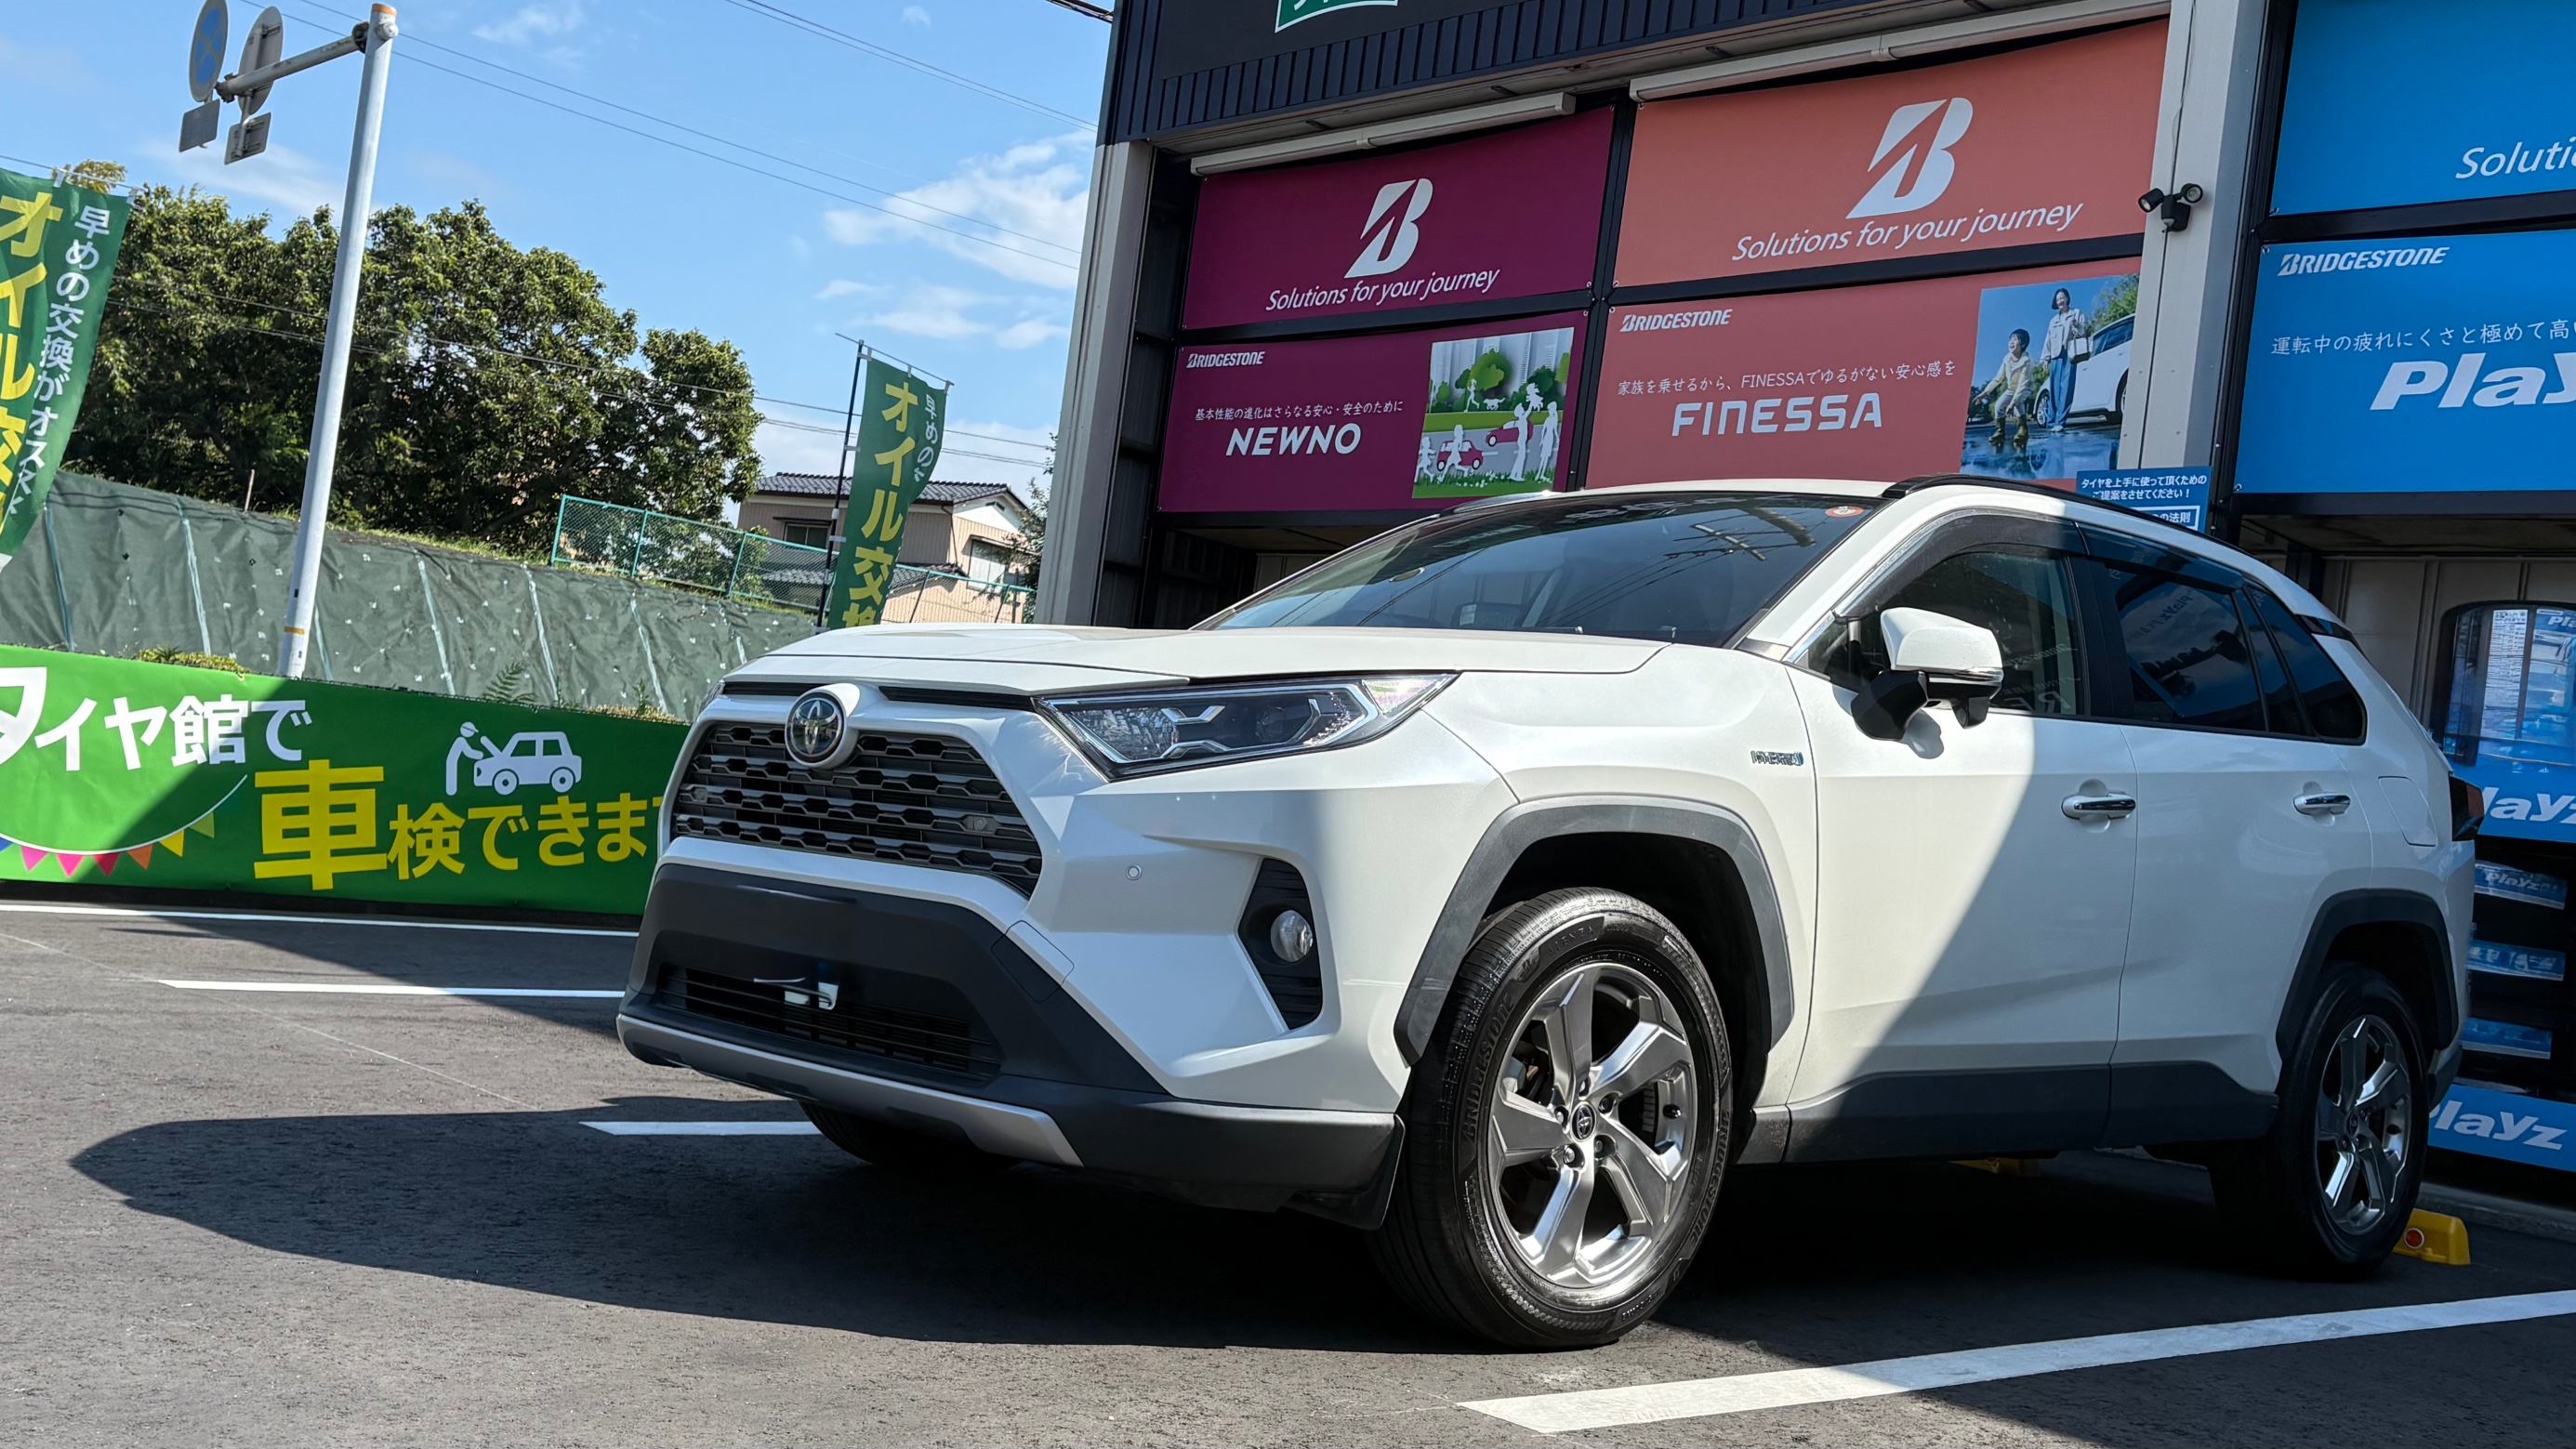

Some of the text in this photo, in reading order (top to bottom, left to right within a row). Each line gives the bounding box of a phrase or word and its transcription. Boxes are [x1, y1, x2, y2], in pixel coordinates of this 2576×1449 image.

[1732, 203, 2084, 260] Solutions for your journey
[2277, 246, 2450, 276] BRIDGESTONE
[1265, 269, 1500, 311] Solutions for your journey
[1619, 309, 1733, 333] BRIDGESTONE
[2271, 319, 2576, 355] 運転中の疲れにくさと極めて高
[1186, 350, 1265, 368] BRIDGESTONE
[1618, 360, 1956, 396] 家族を乗せるから、FINESSAでゆるがない安心感を
[1195, 400, 1404, 421] 基本性能の進化はさらなる安心・安全のために
[1671, 392, 1882, 437] FINESSA
[1225, 422, 1362, 456] NEWNO
[2081, 475, 2208, 489] タイヤを上手に使って頂くための
[254, 759, 666, 890] 車検できま
